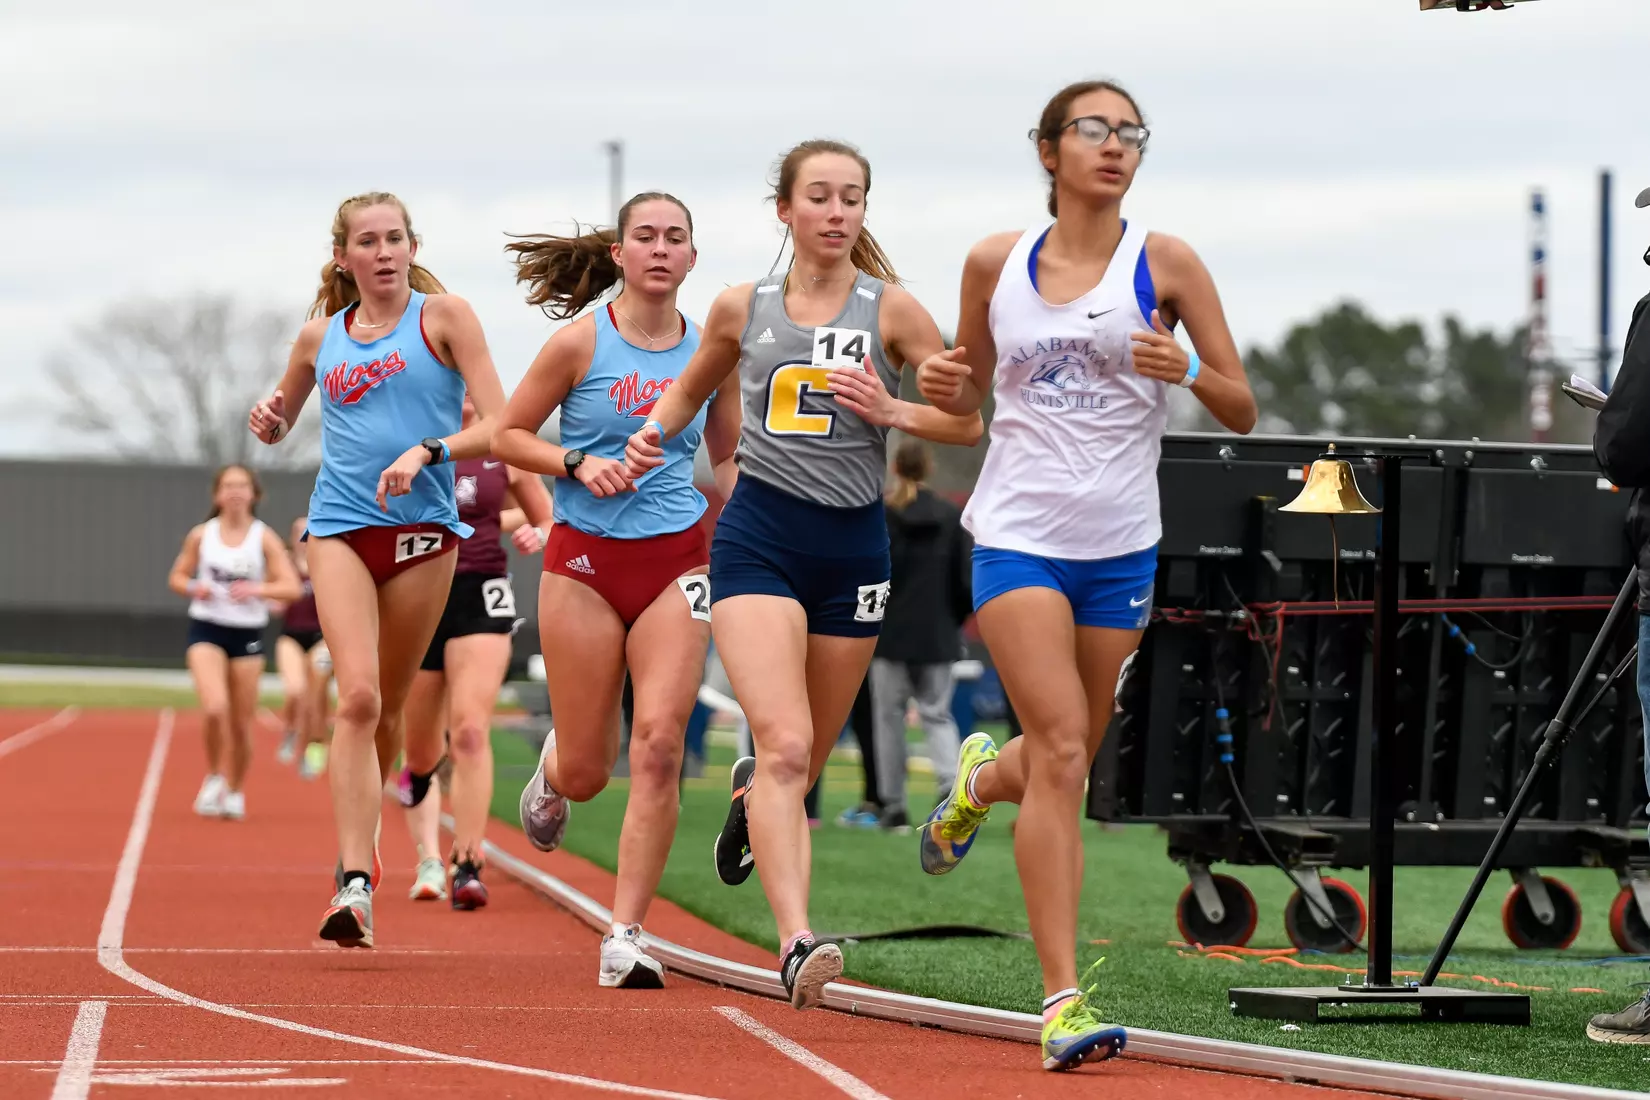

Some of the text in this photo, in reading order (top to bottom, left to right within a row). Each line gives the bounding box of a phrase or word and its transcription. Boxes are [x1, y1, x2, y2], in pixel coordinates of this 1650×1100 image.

[818, 332, 865, 363] 14
[323, 348, 408, 405] Mocs
[1020, 388, 1109, 409] HUNTSVILLE
[400, 536, 439, 556] 17
[565, 561, 595, 575] adidas
